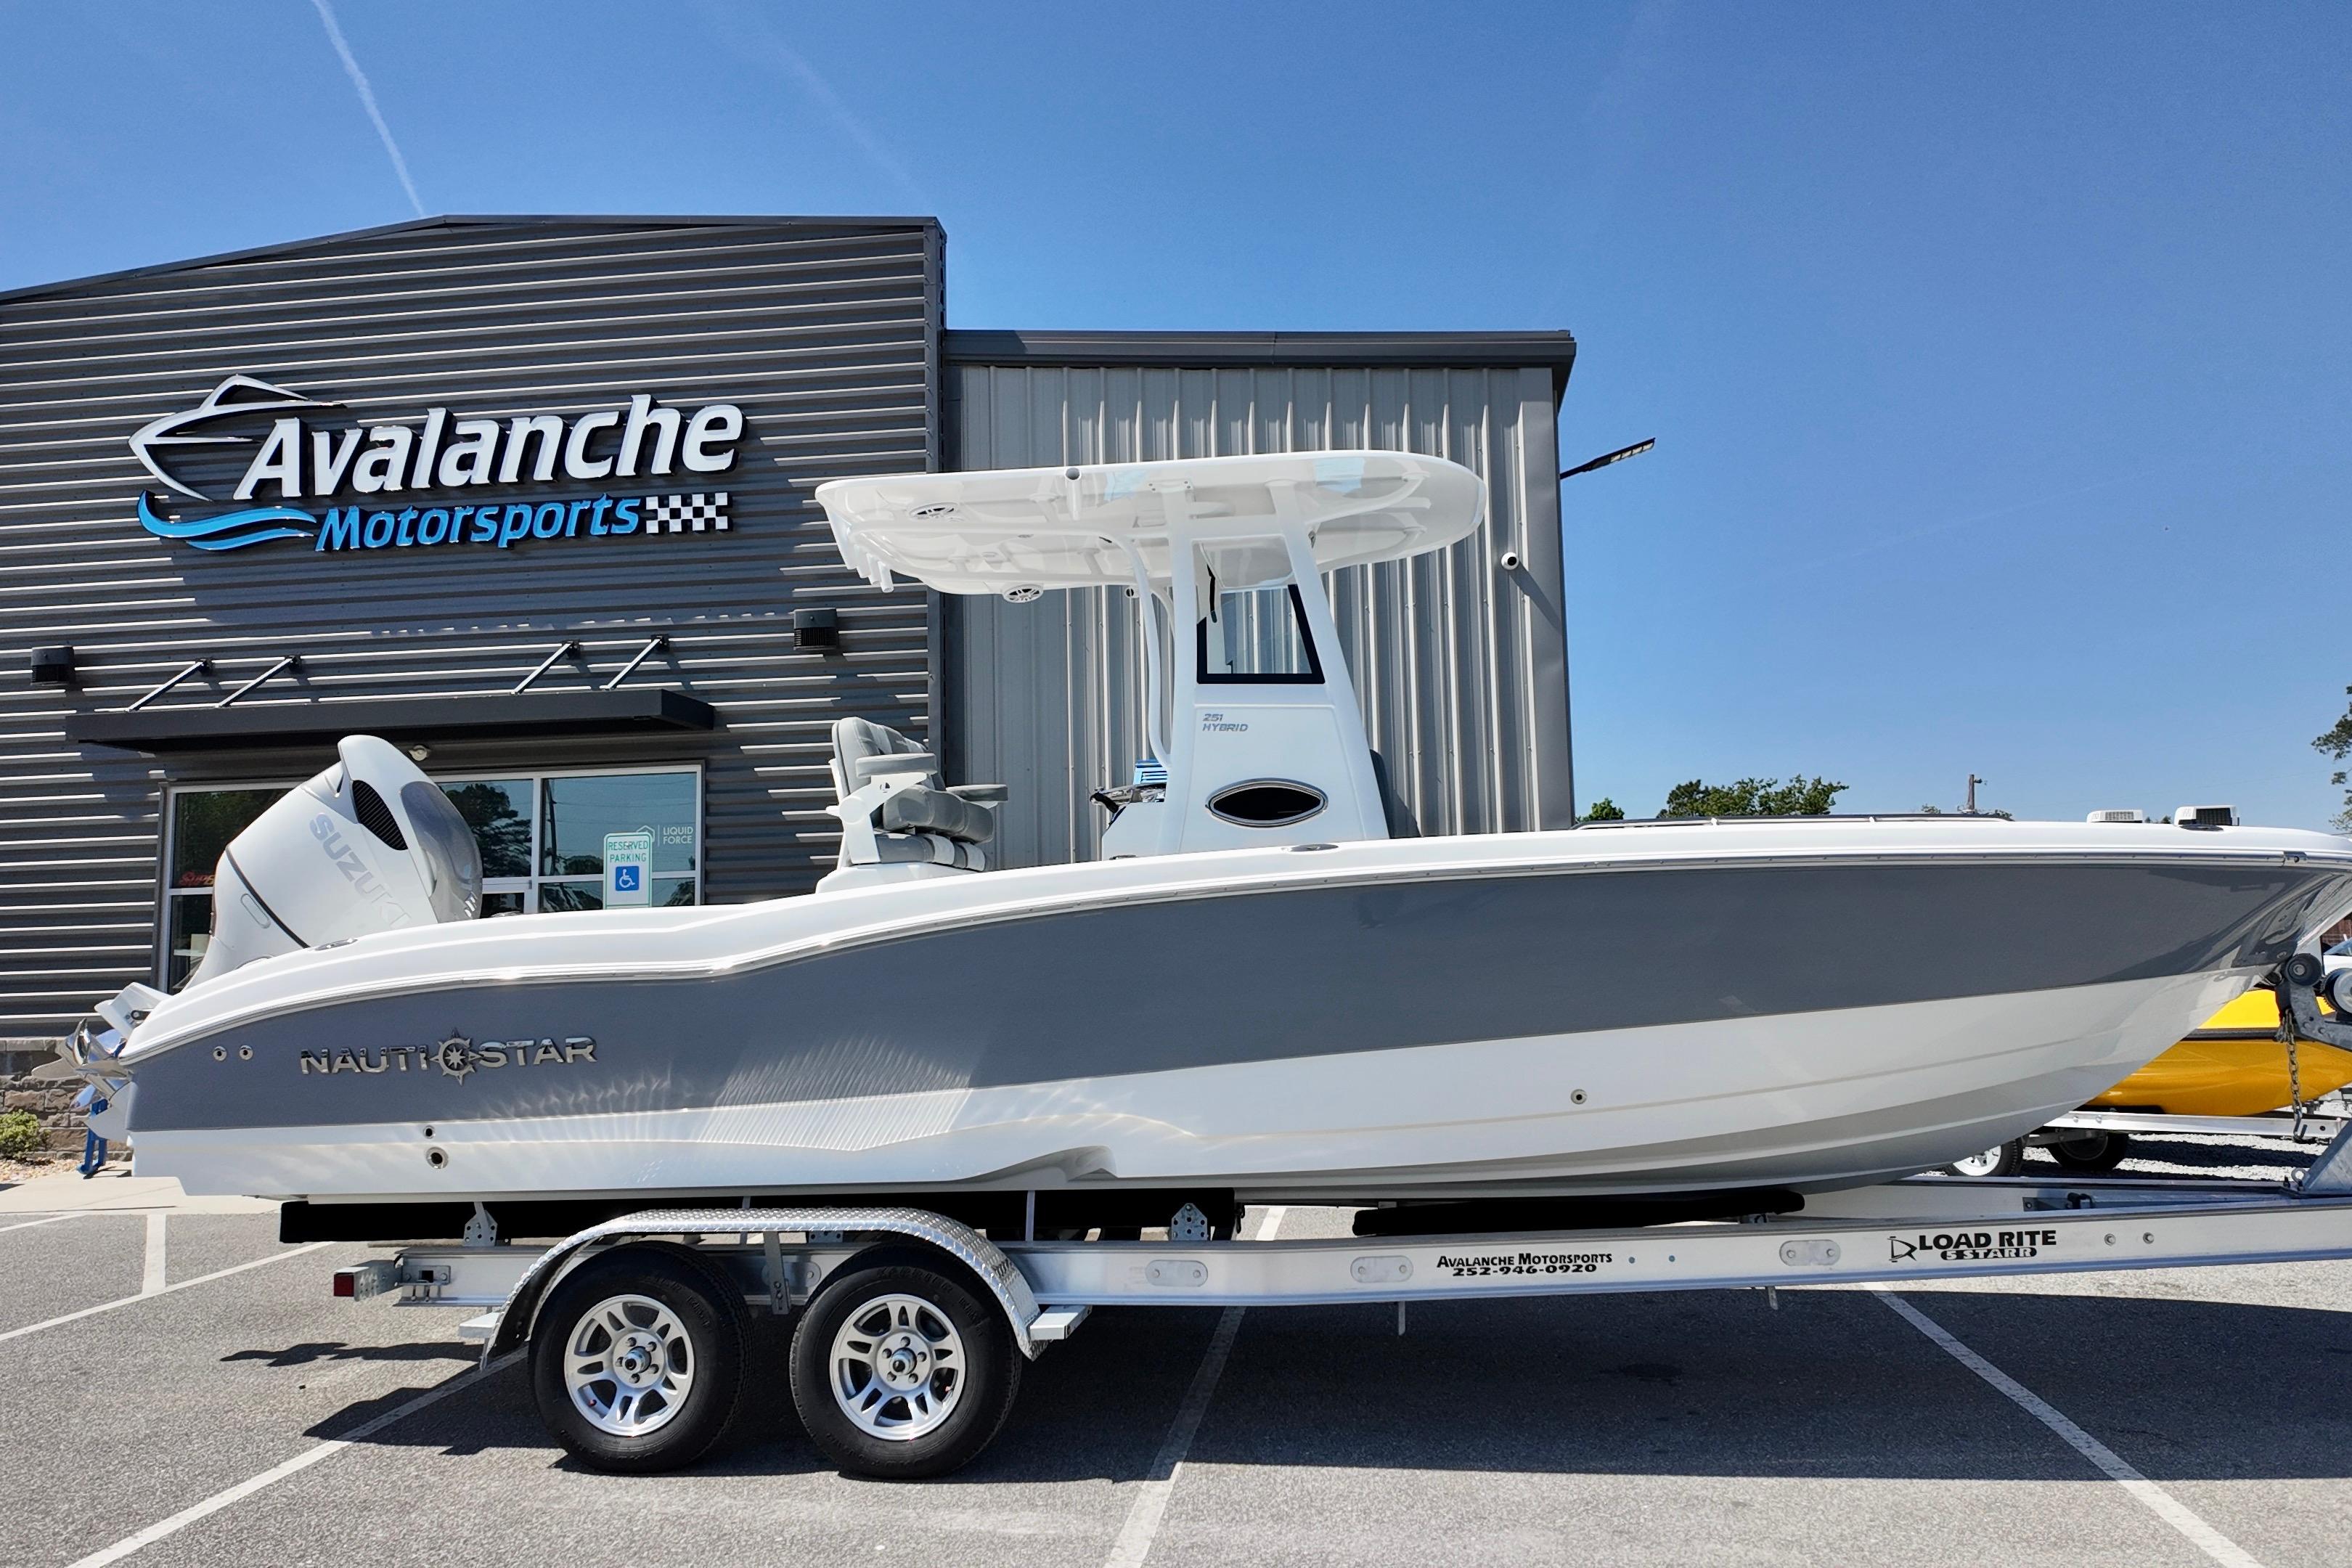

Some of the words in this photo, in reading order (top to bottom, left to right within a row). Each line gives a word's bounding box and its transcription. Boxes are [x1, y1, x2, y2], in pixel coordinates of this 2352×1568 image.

[232, 394, 747, 501] Avalanche
[314, 492, 642, 552] Motorsports
[1202, 713, 1224, 722] 251
[1202, 723, 1249, 732] HYBRID
[663, 826, 694, 836] LIQUID
[608, 840, 649, 851] RESERVED
[663, 836, 693, 844] FORCE
[609, 853, 647, 863] PARKING
[309, 812, 412, 930] SUZUKI
[1919, 1233, 1992, 1251] LOAD
[1998, 1230, 2057, 1247] RITE
[1437, 1255, 1515, 1268] AVALANCHE
[1519, 1252, 1613, 1265] MOTORSPORTS
[1946, 1250, 1958, 1260] 5
[1453, 1264, 1597, 1276] 252-946-0920
